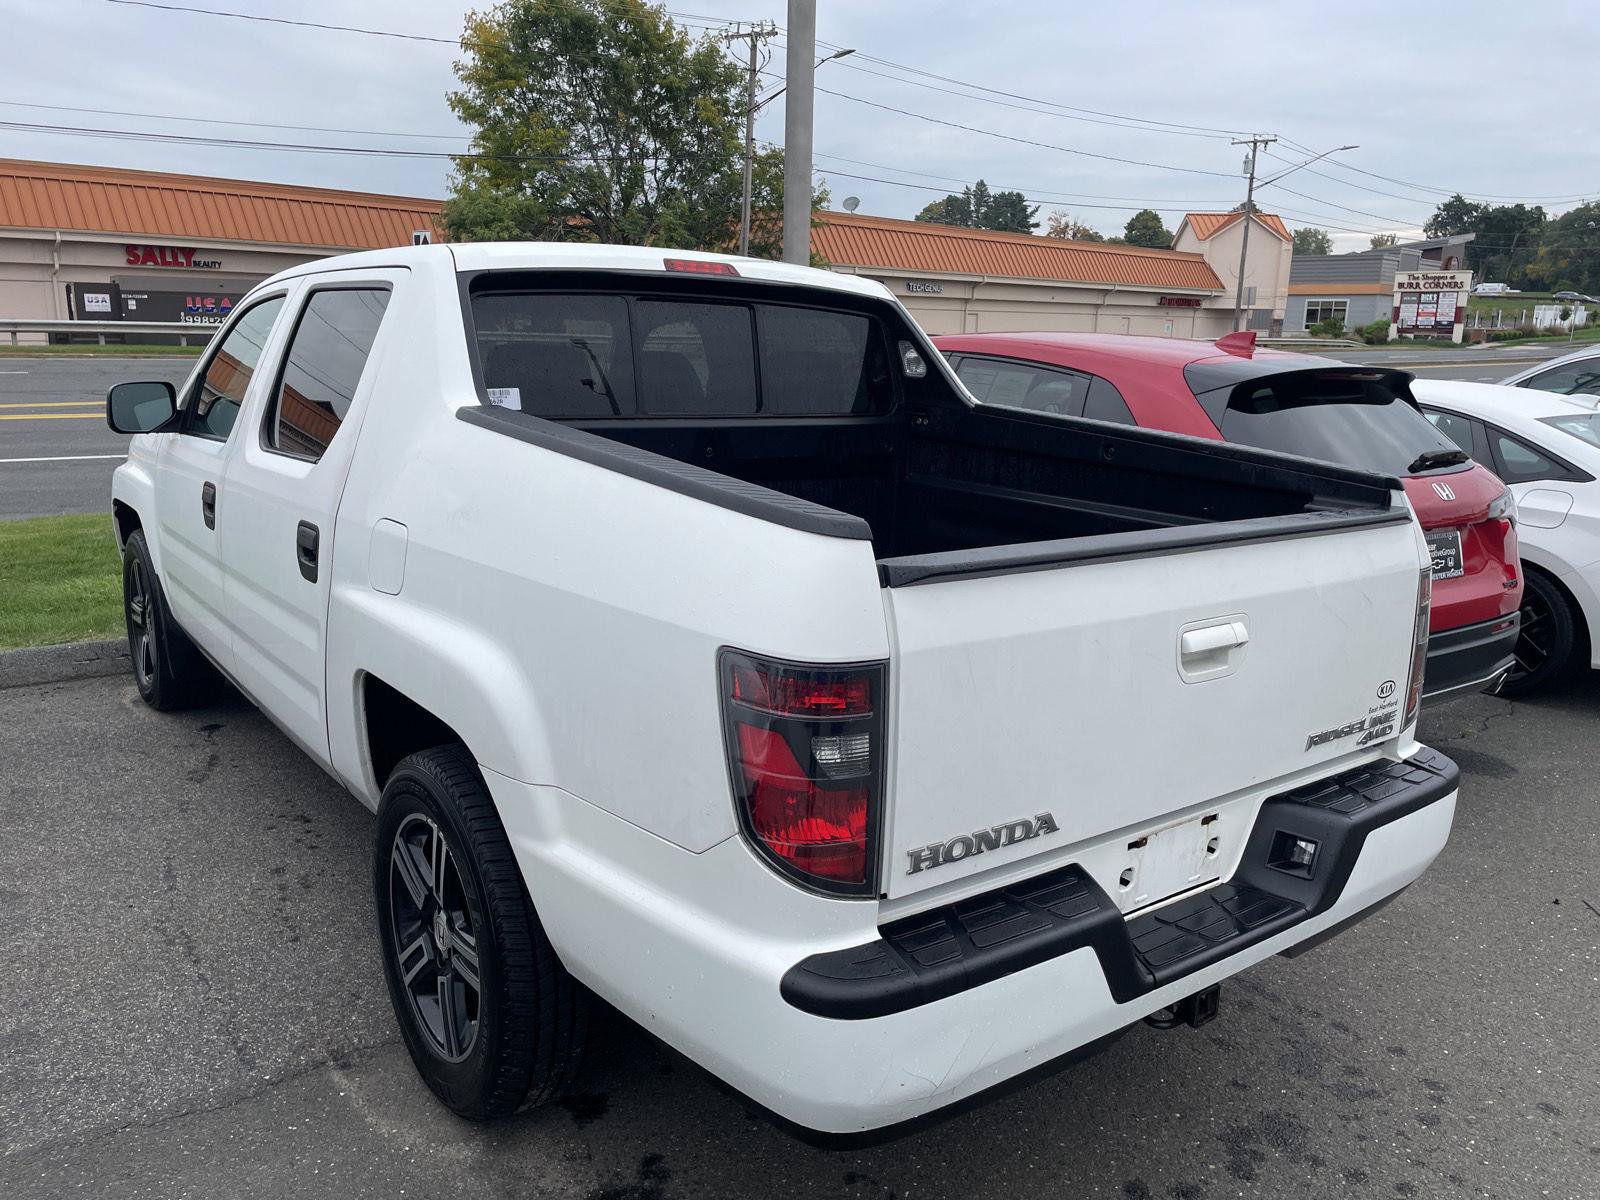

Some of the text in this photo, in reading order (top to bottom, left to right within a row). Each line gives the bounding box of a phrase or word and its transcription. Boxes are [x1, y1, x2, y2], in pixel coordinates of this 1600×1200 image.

[126, 245, 222, 269] SALLY BEAUTY
[1398, 281, 1464, 290] BURR CORNERS
[1421, 274, 1448, 282] Shoppes
[1368, 706, 1379, 715] East
[1305, 709, 1398, 753] RIDGELINE
[1356, 723, 1394, 746] 4WD
[905, 811, 1060, 876] HONDA
